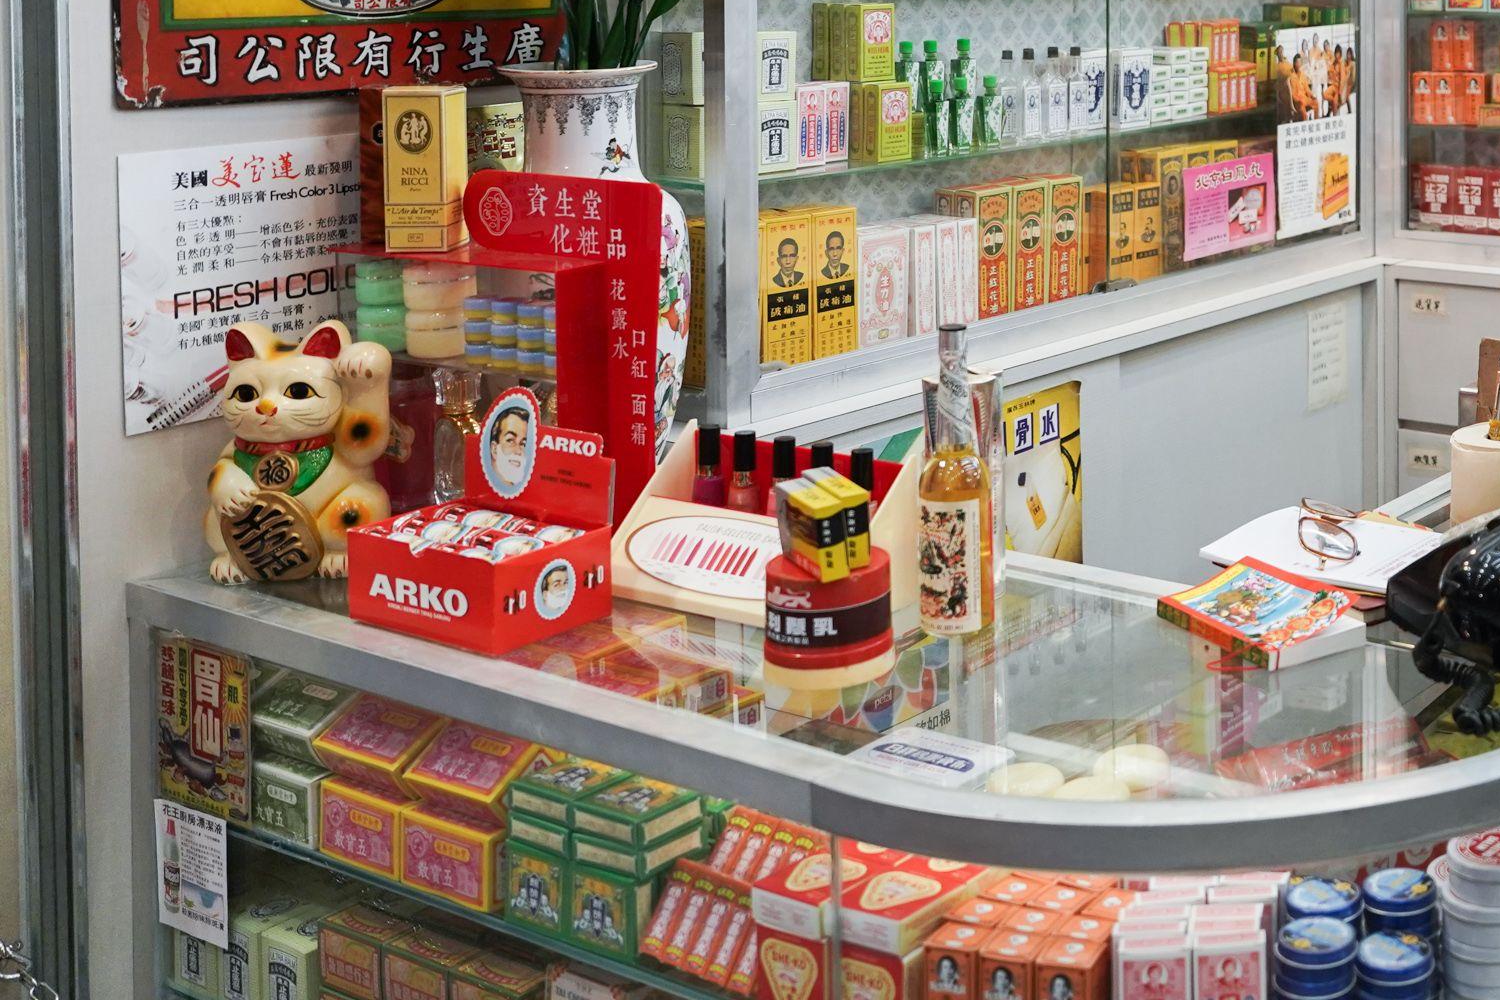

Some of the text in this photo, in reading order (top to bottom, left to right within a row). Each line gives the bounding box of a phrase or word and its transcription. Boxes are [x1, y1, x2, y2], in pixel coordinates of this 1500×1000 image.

[178, 22, 542, 86] 廣生行有限公司
[172, 170, 208, 190] 美國
[401, 168, 428, 176] NINA
[401, 177, 429, 187] RICCI
[1195, 161, 1265, 191] 北京白鳳丸
[270, 189, 297, 201] Fresh
[299, 187, 327, 199] Color
[527, 183, 602, 221] 資生堂
[550, 224, 627, 261] 化粧品
[173, 276, 279, 320] FRESH
[609, 278, 629, 360] 花露水
[631, 330, 648, 446] 口紅 面霜
[538, 433, 597, 458] ARKO
[369, 572, 469, 618] ARKO
[771, 950, 807, 971] SHE-KO
[845, 970, 884, 990] SHE-KO
